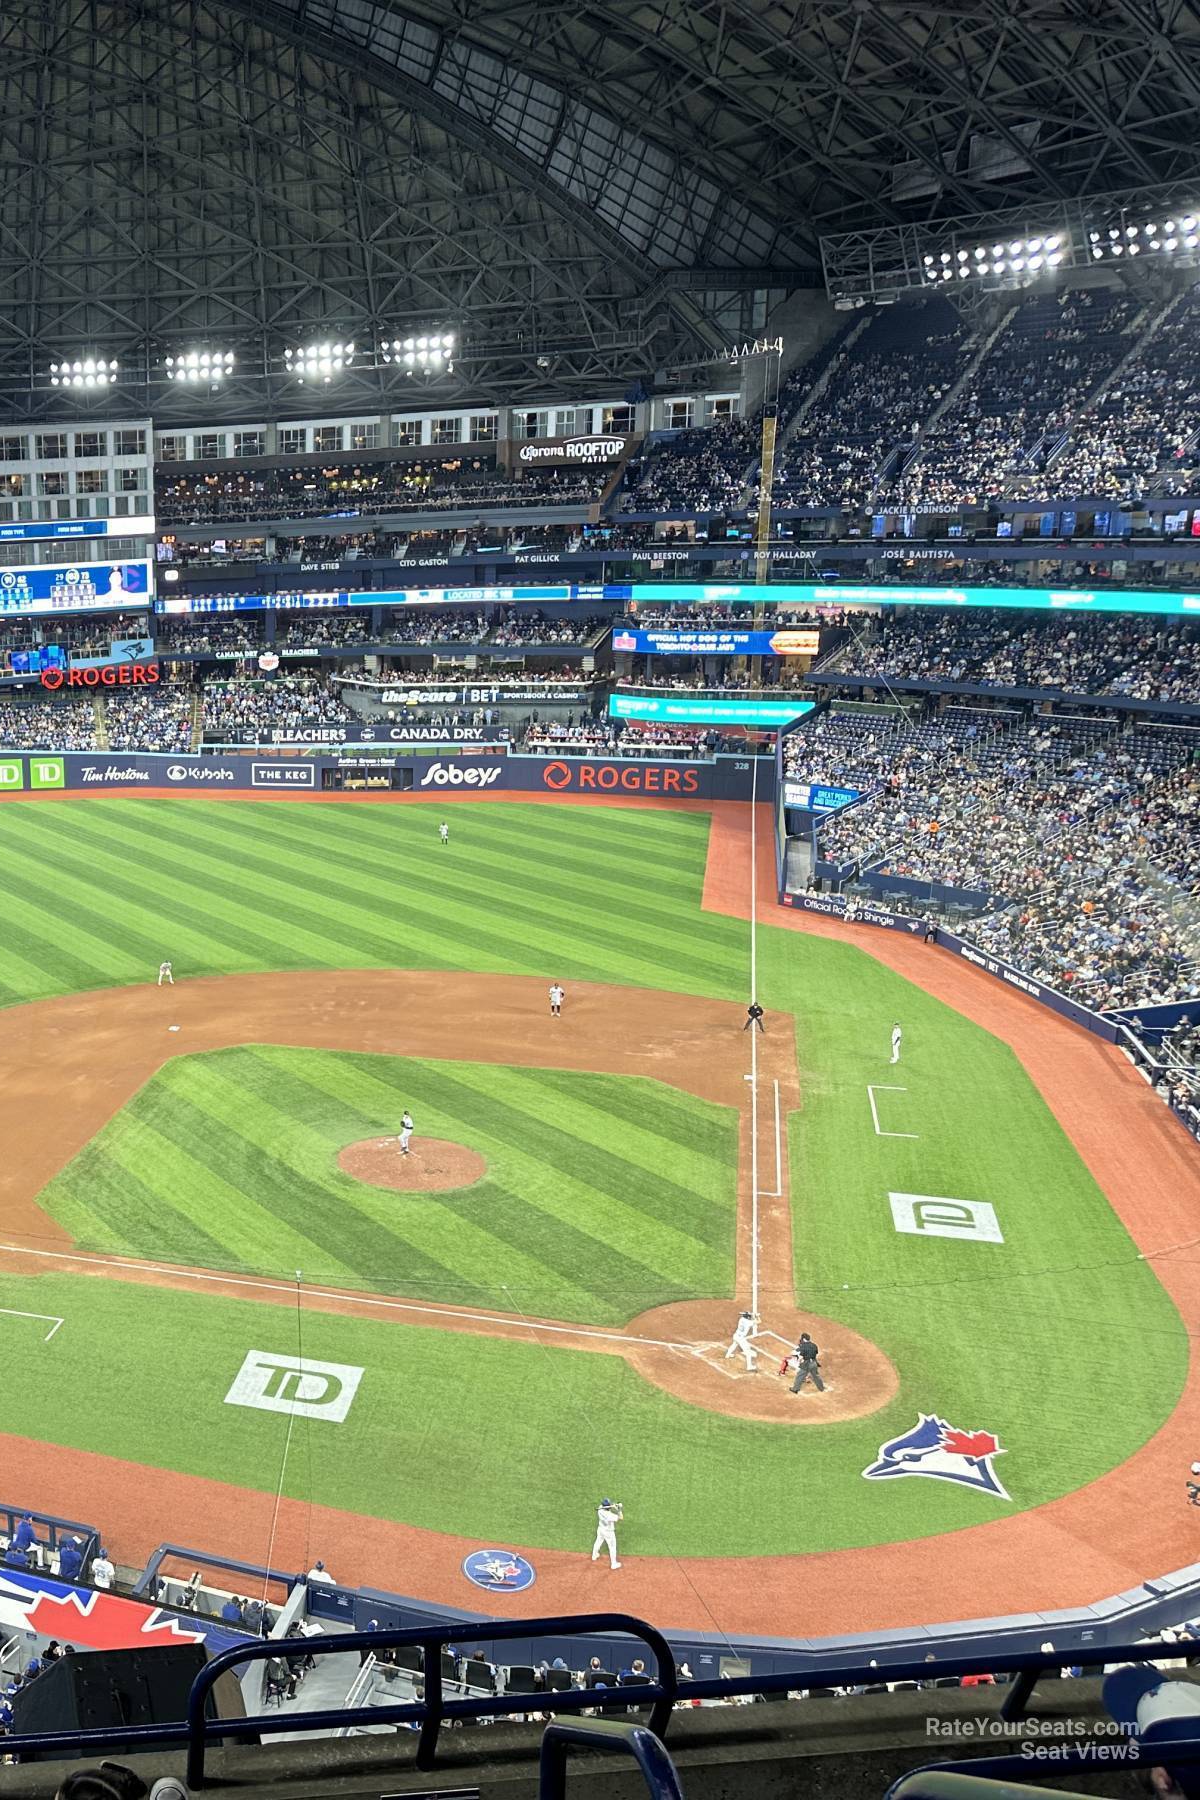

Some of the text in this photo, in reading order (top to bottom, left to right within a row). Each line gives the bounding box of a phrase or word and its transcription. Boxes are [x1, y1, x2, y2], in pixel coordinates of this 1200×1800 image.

[520, 441, 624, 461] Corona ROOFTOP
[878, 505, 958, 515] JACKIE ROBINSON
[515, 555, 528, 563] PAT
[653, 552, 689, 560] BEESTON
[772, 551, 816, 559] HALLADAY
[909, 550, 955, 559] BAUTISTA
[419, 558, 448, 566] GASTON
[282, 648, 318, 656] BLEACHERS
[68, 664, 159, 687] ROGERS
[382, 689, 457, 703] theScore
[471, 689, 499, 702] BET
[390, 728, 451, 740] CANADA
[734, 762, 749, 770] 328
[35, 764, 61, 782] TD
[81, 765, 149, 782] Tim Hortons
[189, 768, 234, 780] Kubota
[259, 770, 308, 779] THE KEG
[421, 762, 501, 787] Sobeys
[580, 766, 698, 792] ROGERS
[818, 790, 834, 799] GREAT
[804, 898, 895, 926] Official Shingle
[256, 1362, 343, 1405] TD
